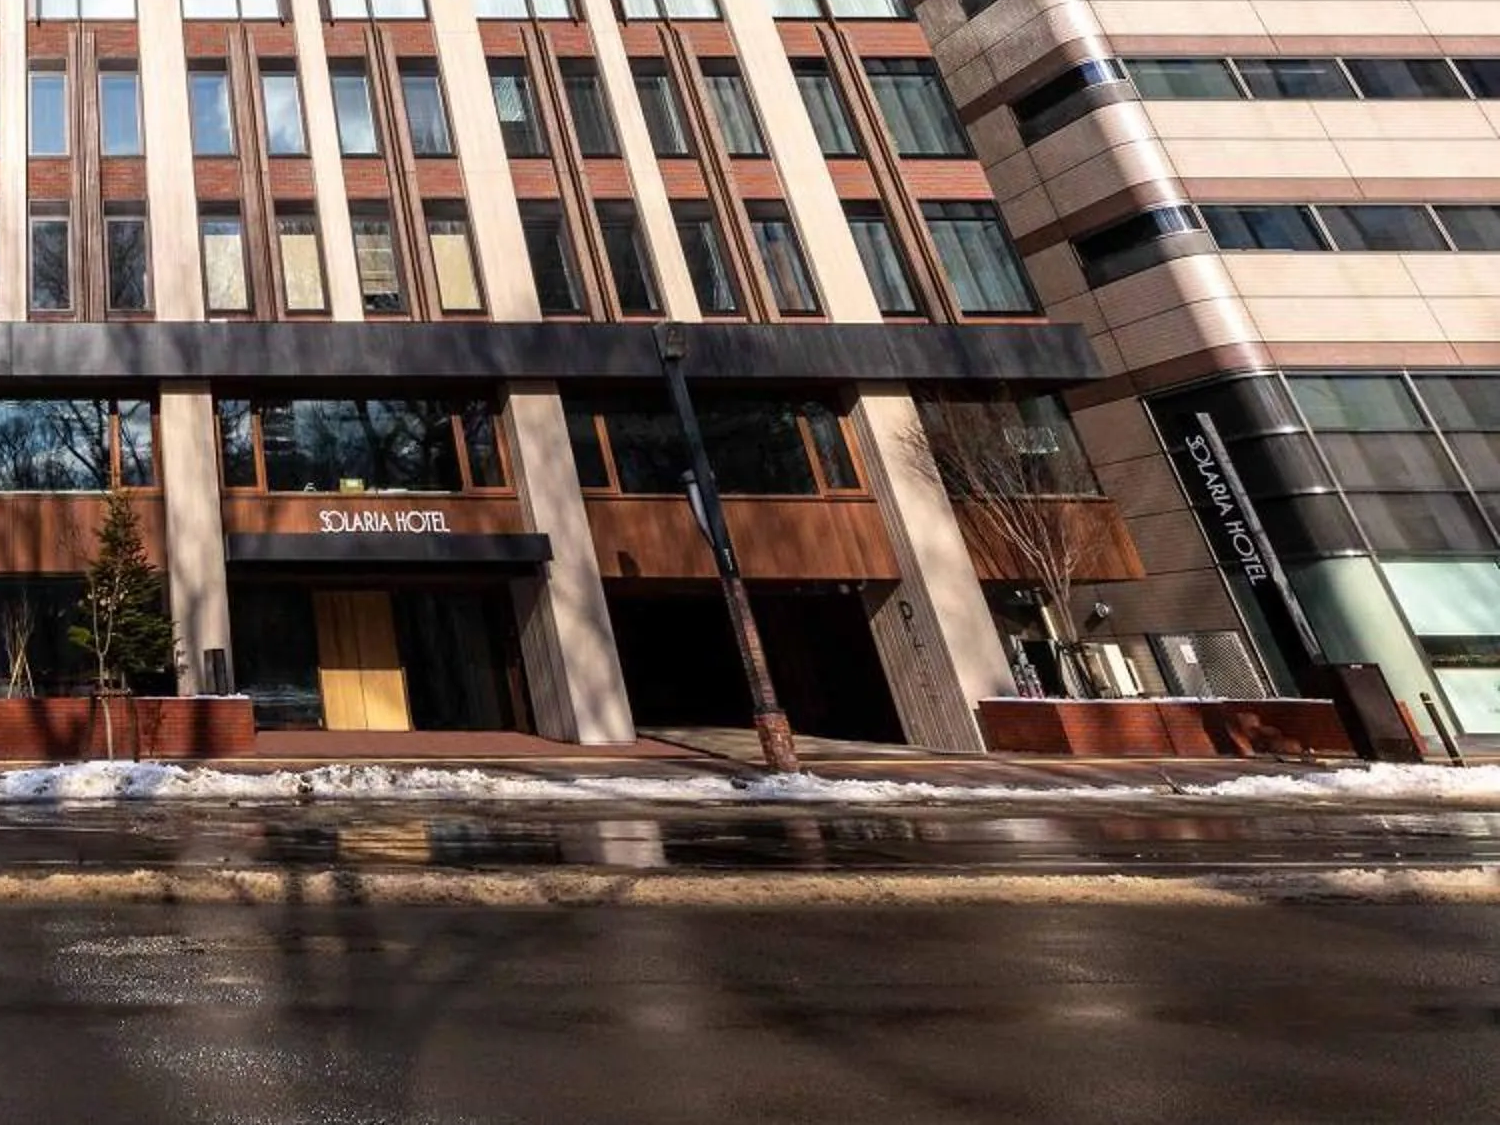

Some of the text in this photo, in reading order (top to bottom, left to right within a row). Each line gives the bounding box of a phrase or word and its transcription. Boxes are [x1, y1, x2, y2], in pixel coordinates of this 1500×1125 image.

[319, 510, 451, 533] SOLARIA HOTEL
[1185, 433, 1267, 586] SOLARIA HOTEL
